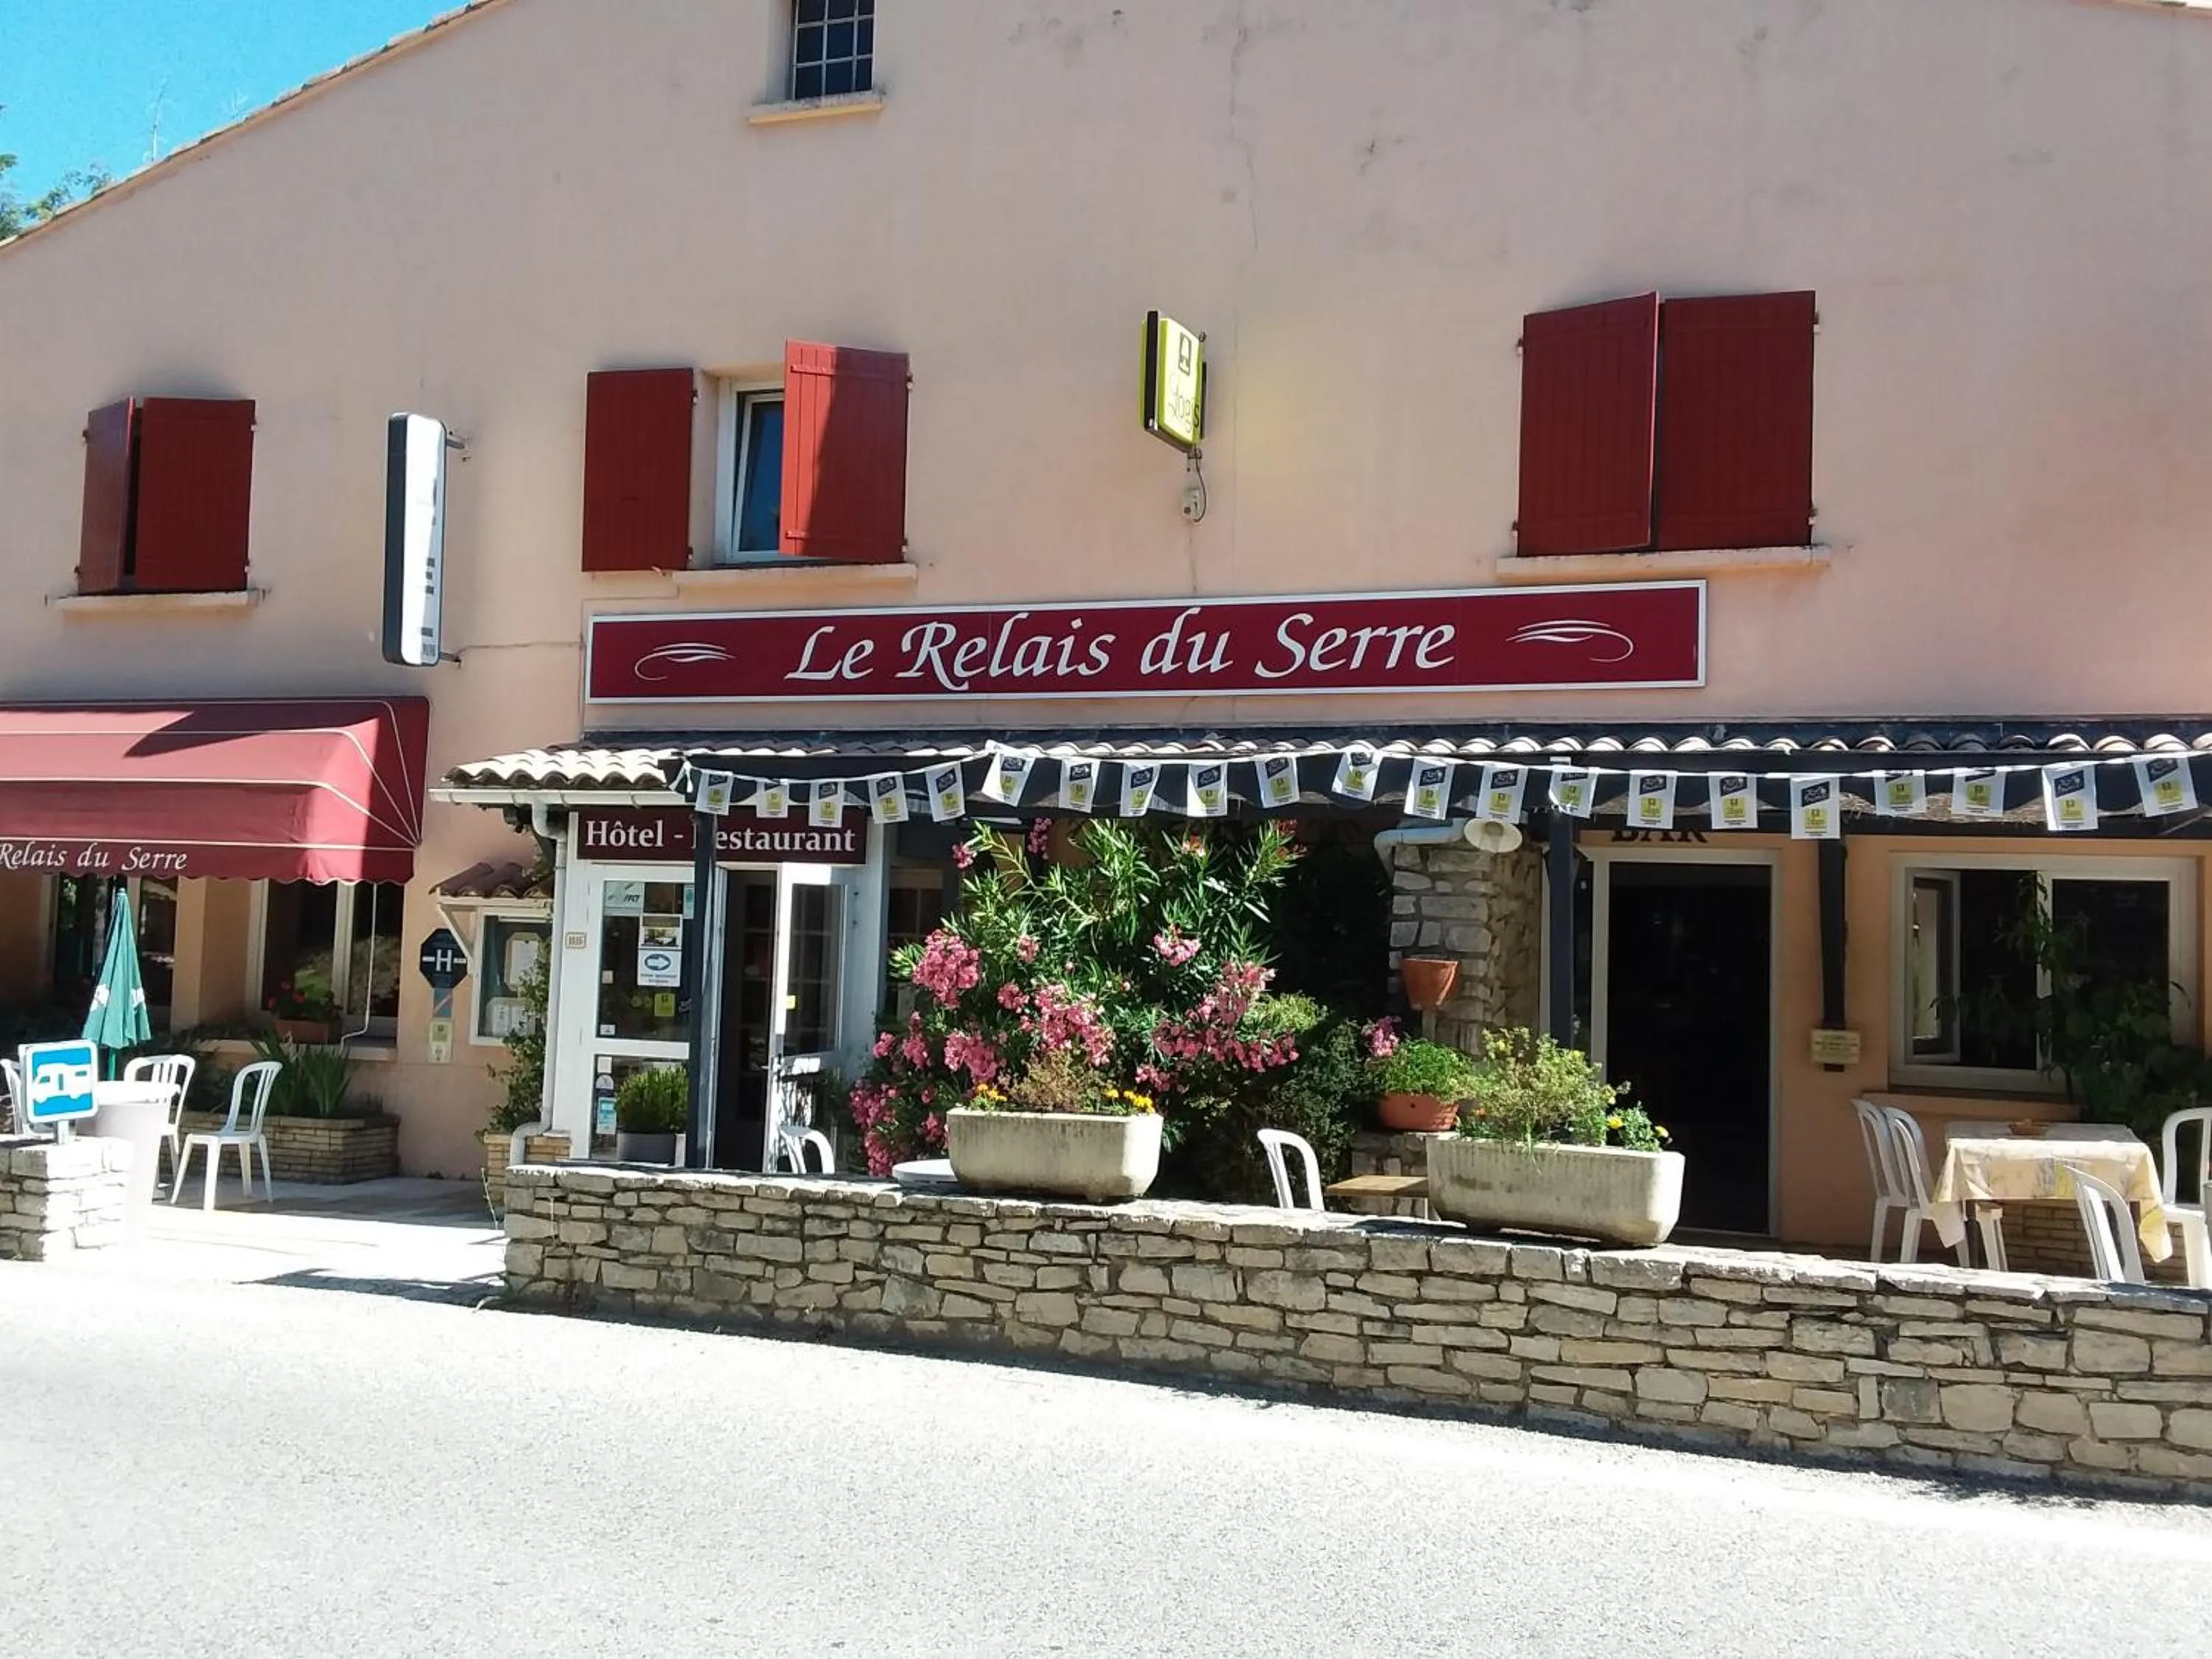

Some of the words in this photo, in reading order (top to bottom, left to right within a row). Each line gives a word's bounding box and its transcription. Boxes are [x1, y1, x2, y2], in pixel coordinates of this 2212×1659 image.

[784, 626, 874, 680] Le
[895, 612, 1116, 690] Relais
[1140, 607, 1234, 674] du
[1254, 613, 1455, 678] Serre
[585, 819, 664, 847] Hôtel
[692, 822, 855, 852] estaurant
[0, 839, 68, 870] Relais
[77, 841, 110, 867] du
[122, 846, 188, 870] Serre
[436, 949, 452, 973] H
